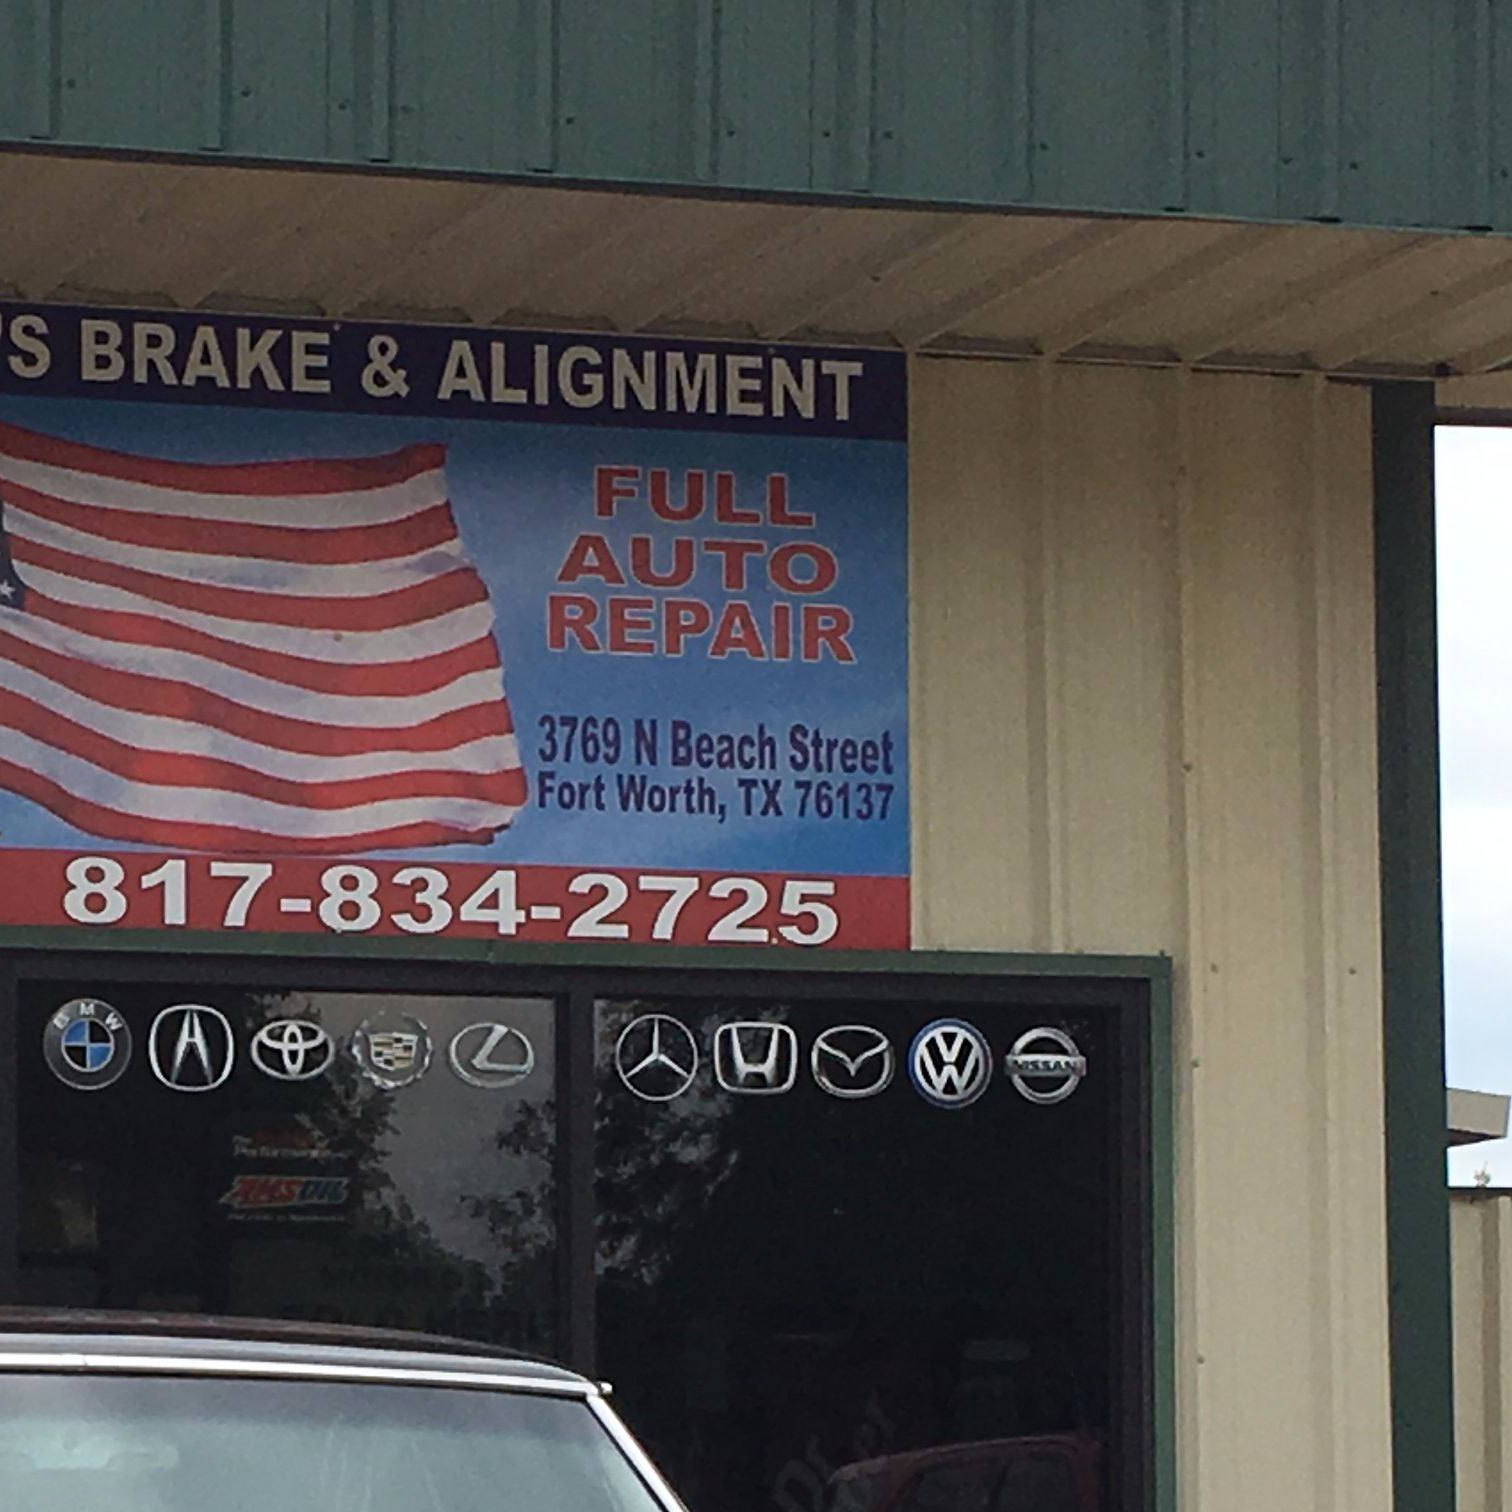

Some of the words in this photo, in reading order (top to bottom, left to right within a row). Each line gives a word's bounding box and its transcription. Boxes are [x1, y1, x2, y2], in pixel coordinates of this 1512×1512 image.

[80, 318, 332, 394] BRAKE
[361, 334, 409, 399] &
[436, 339, 865, 421] ALIGNMENT
[593, 464, 816, 528] FULL
[555, 533, 839, 595] AUTO
[546, 593, 859, 665] REPAIR
[537, 714, 622, 766] 3769
[633, 718, 658, 767] N
[671, 720, 777, 771] Beach
[788, 722, 894, 776] Street
[537, 769, 606, 812] Fort
[616, 772, 727, 824] Worth,
[737, 778, 783, 817] TX
[794, 779, 895, 821] 76137
[62, 855, 841, 947] 817-834-2725
